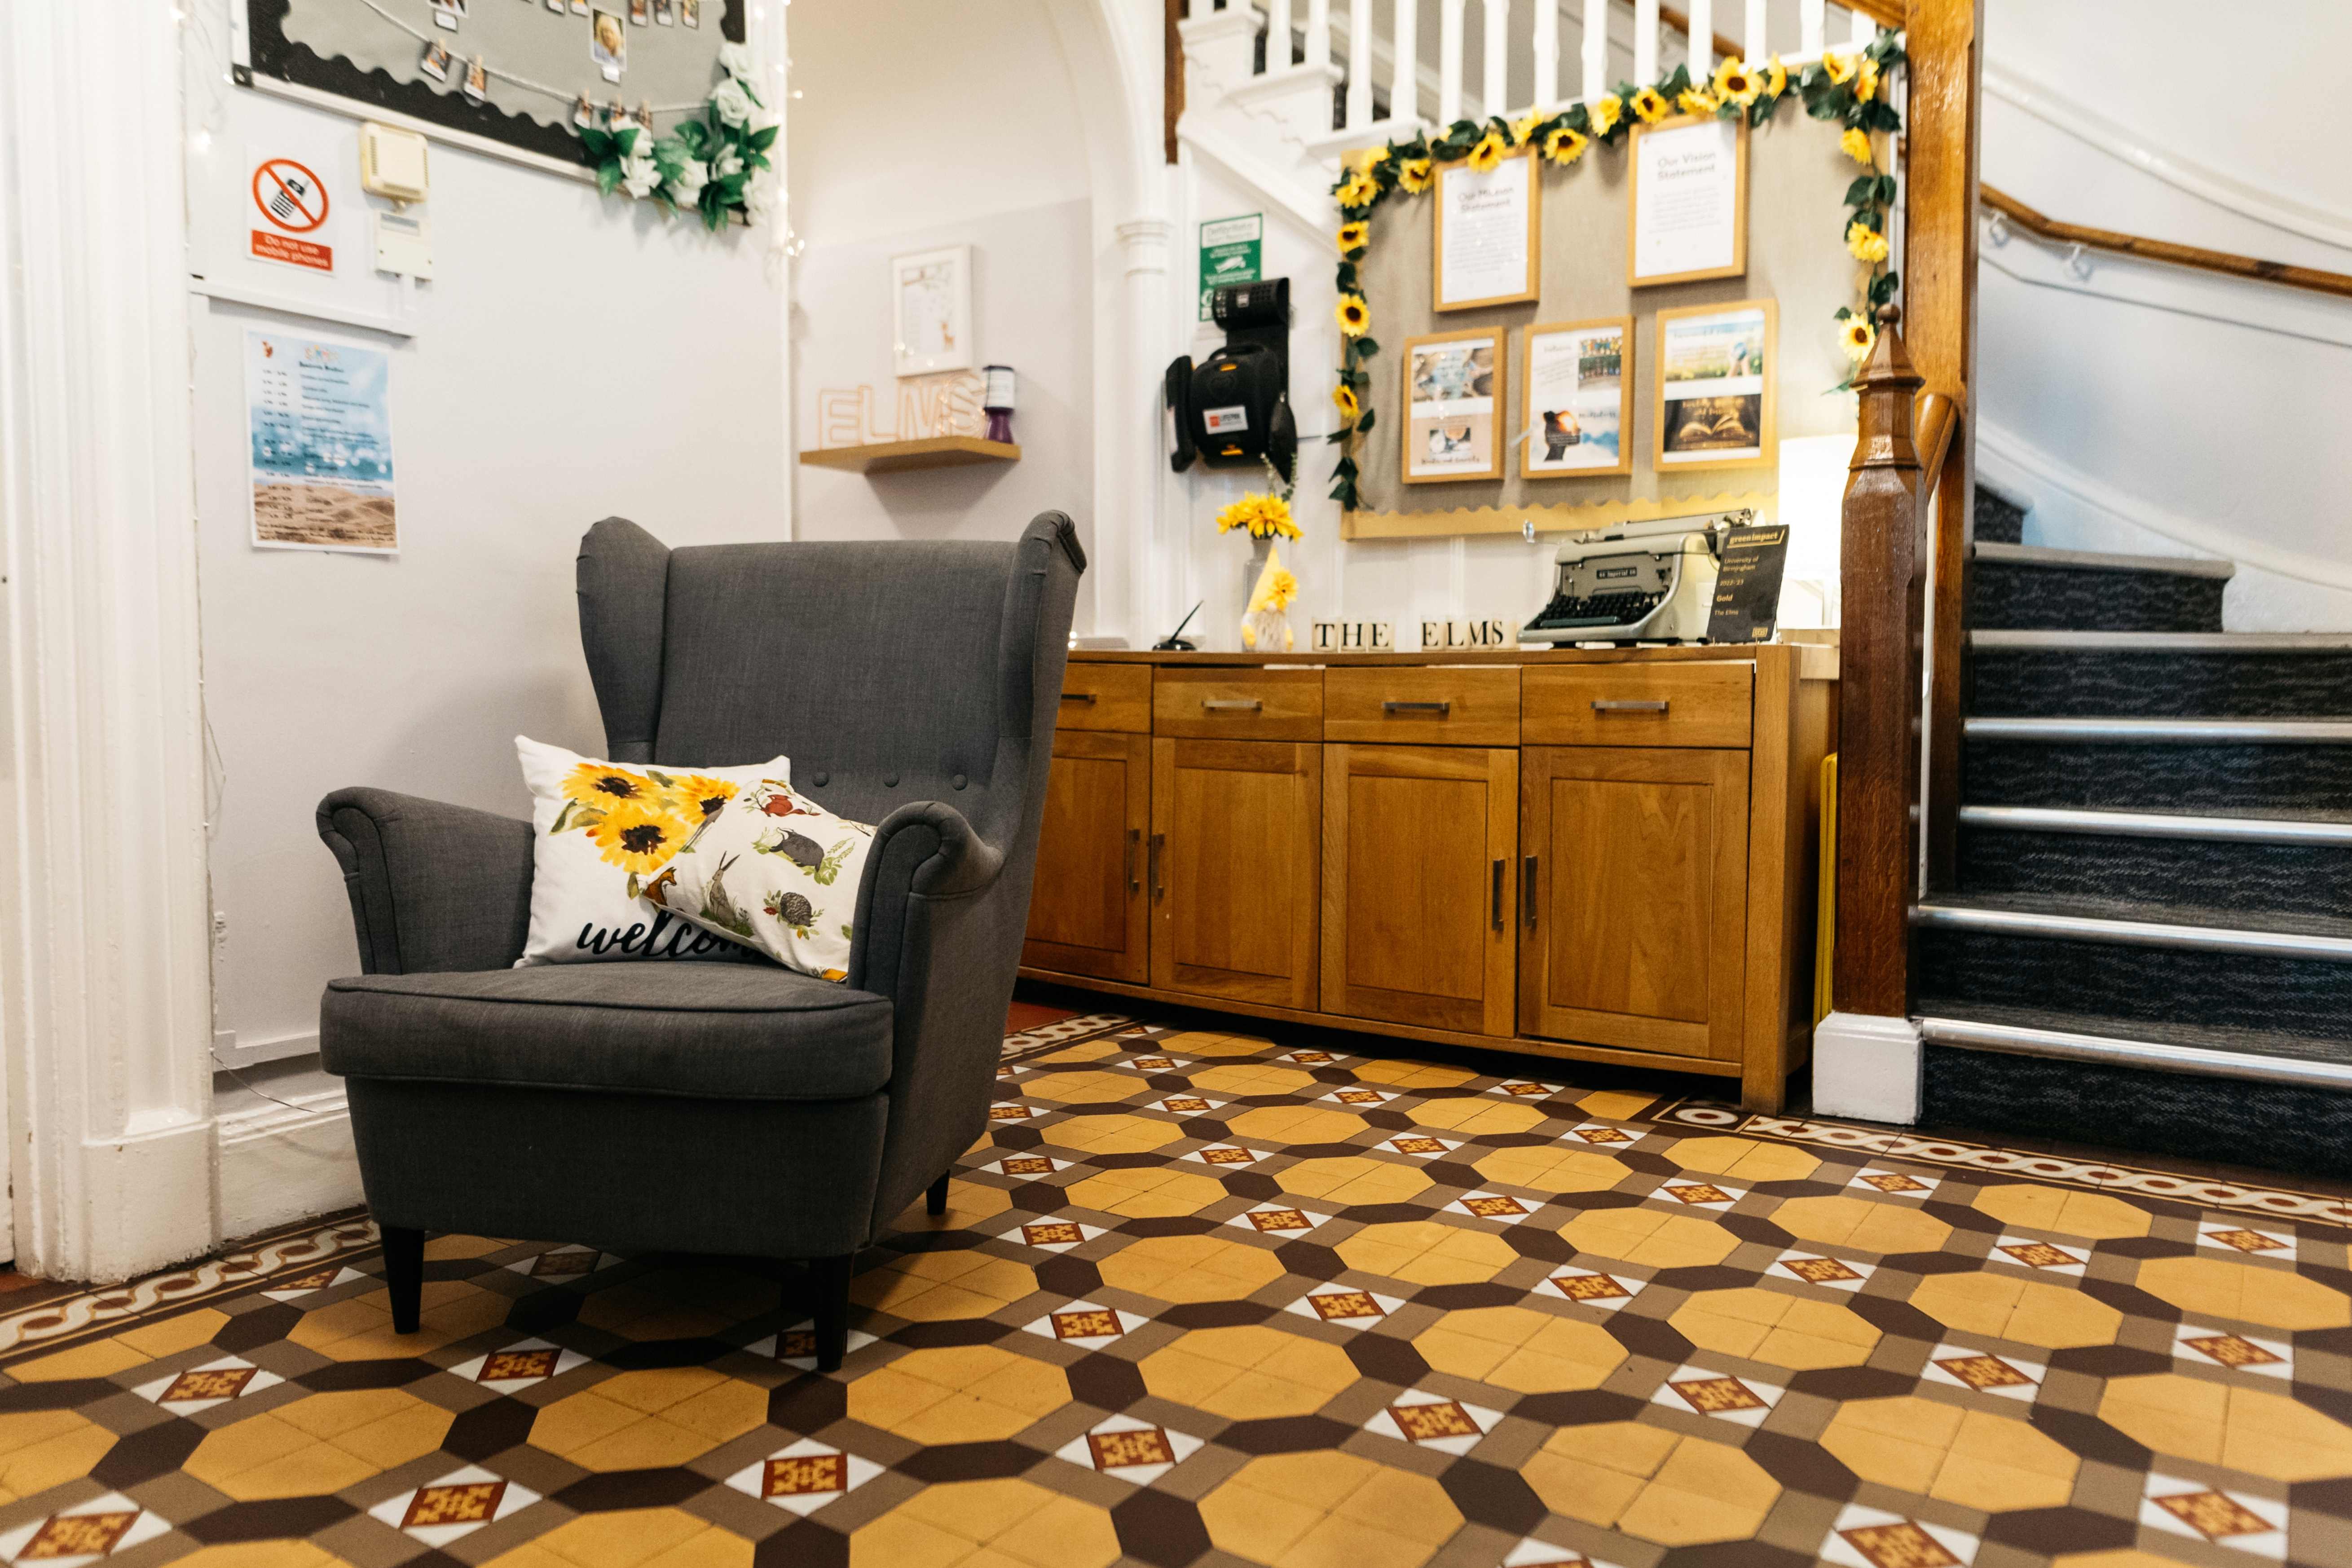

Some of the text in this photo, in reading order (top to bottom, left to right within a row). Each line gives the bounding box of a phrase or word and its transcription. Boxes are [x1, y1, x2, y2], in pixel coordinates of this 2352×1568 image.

[1658, 151, 1716, 169] Our Vision
[1658, 164, 1714, 181] Statement
[1461, 198, 1511, 212] Statement
[265, 235, 280, 247] Do
[282, 241, 298, 251] not
[256, 244, 329, 267] mobile phones
[1723, 564, 1756, 573] Birmingham
[1717, 593, 1733, 602] Gold
[1315, 621, 1503, 647] THE ELMS
[577, 908, 766, 960] welco
